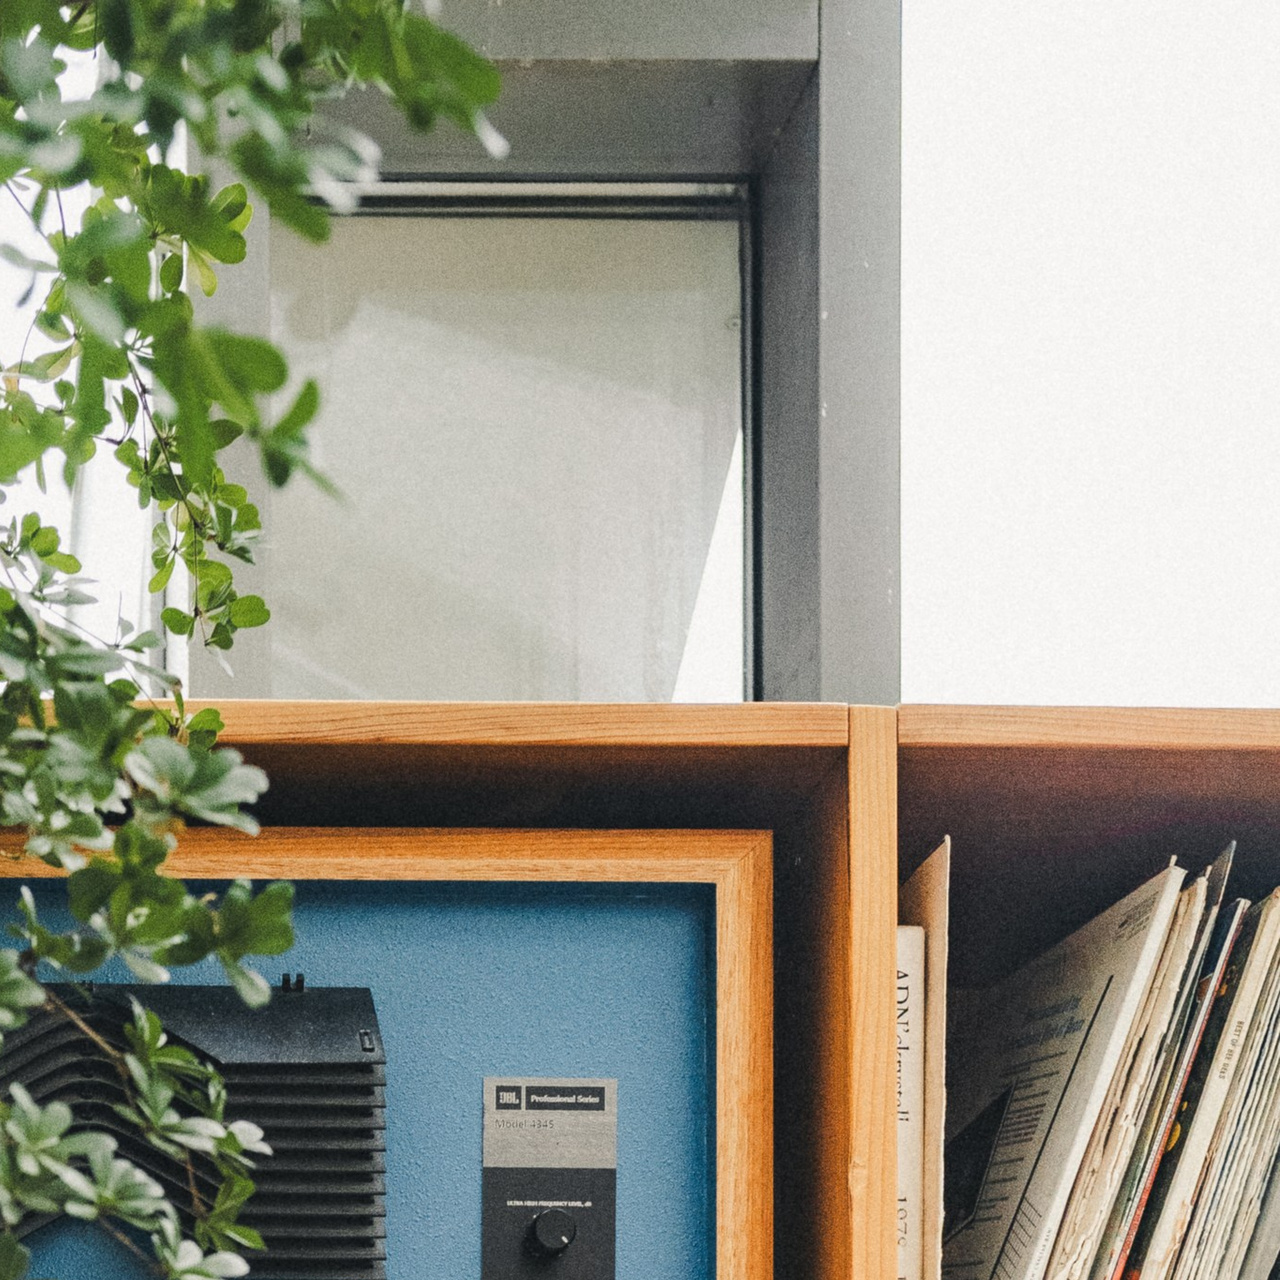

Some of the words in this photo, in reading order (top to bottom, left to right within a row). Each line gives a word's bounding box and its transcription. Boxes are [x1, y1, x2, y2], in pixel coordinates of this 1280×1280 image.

[1231, 1019, 1245, 1038] BEST
[500, 1092, 519, 1104] JBL
[531, 1095, 576, 1103] Professional
[577, 1095, 600, 1103] Series
[495, 1119, 527, 1129] Model
